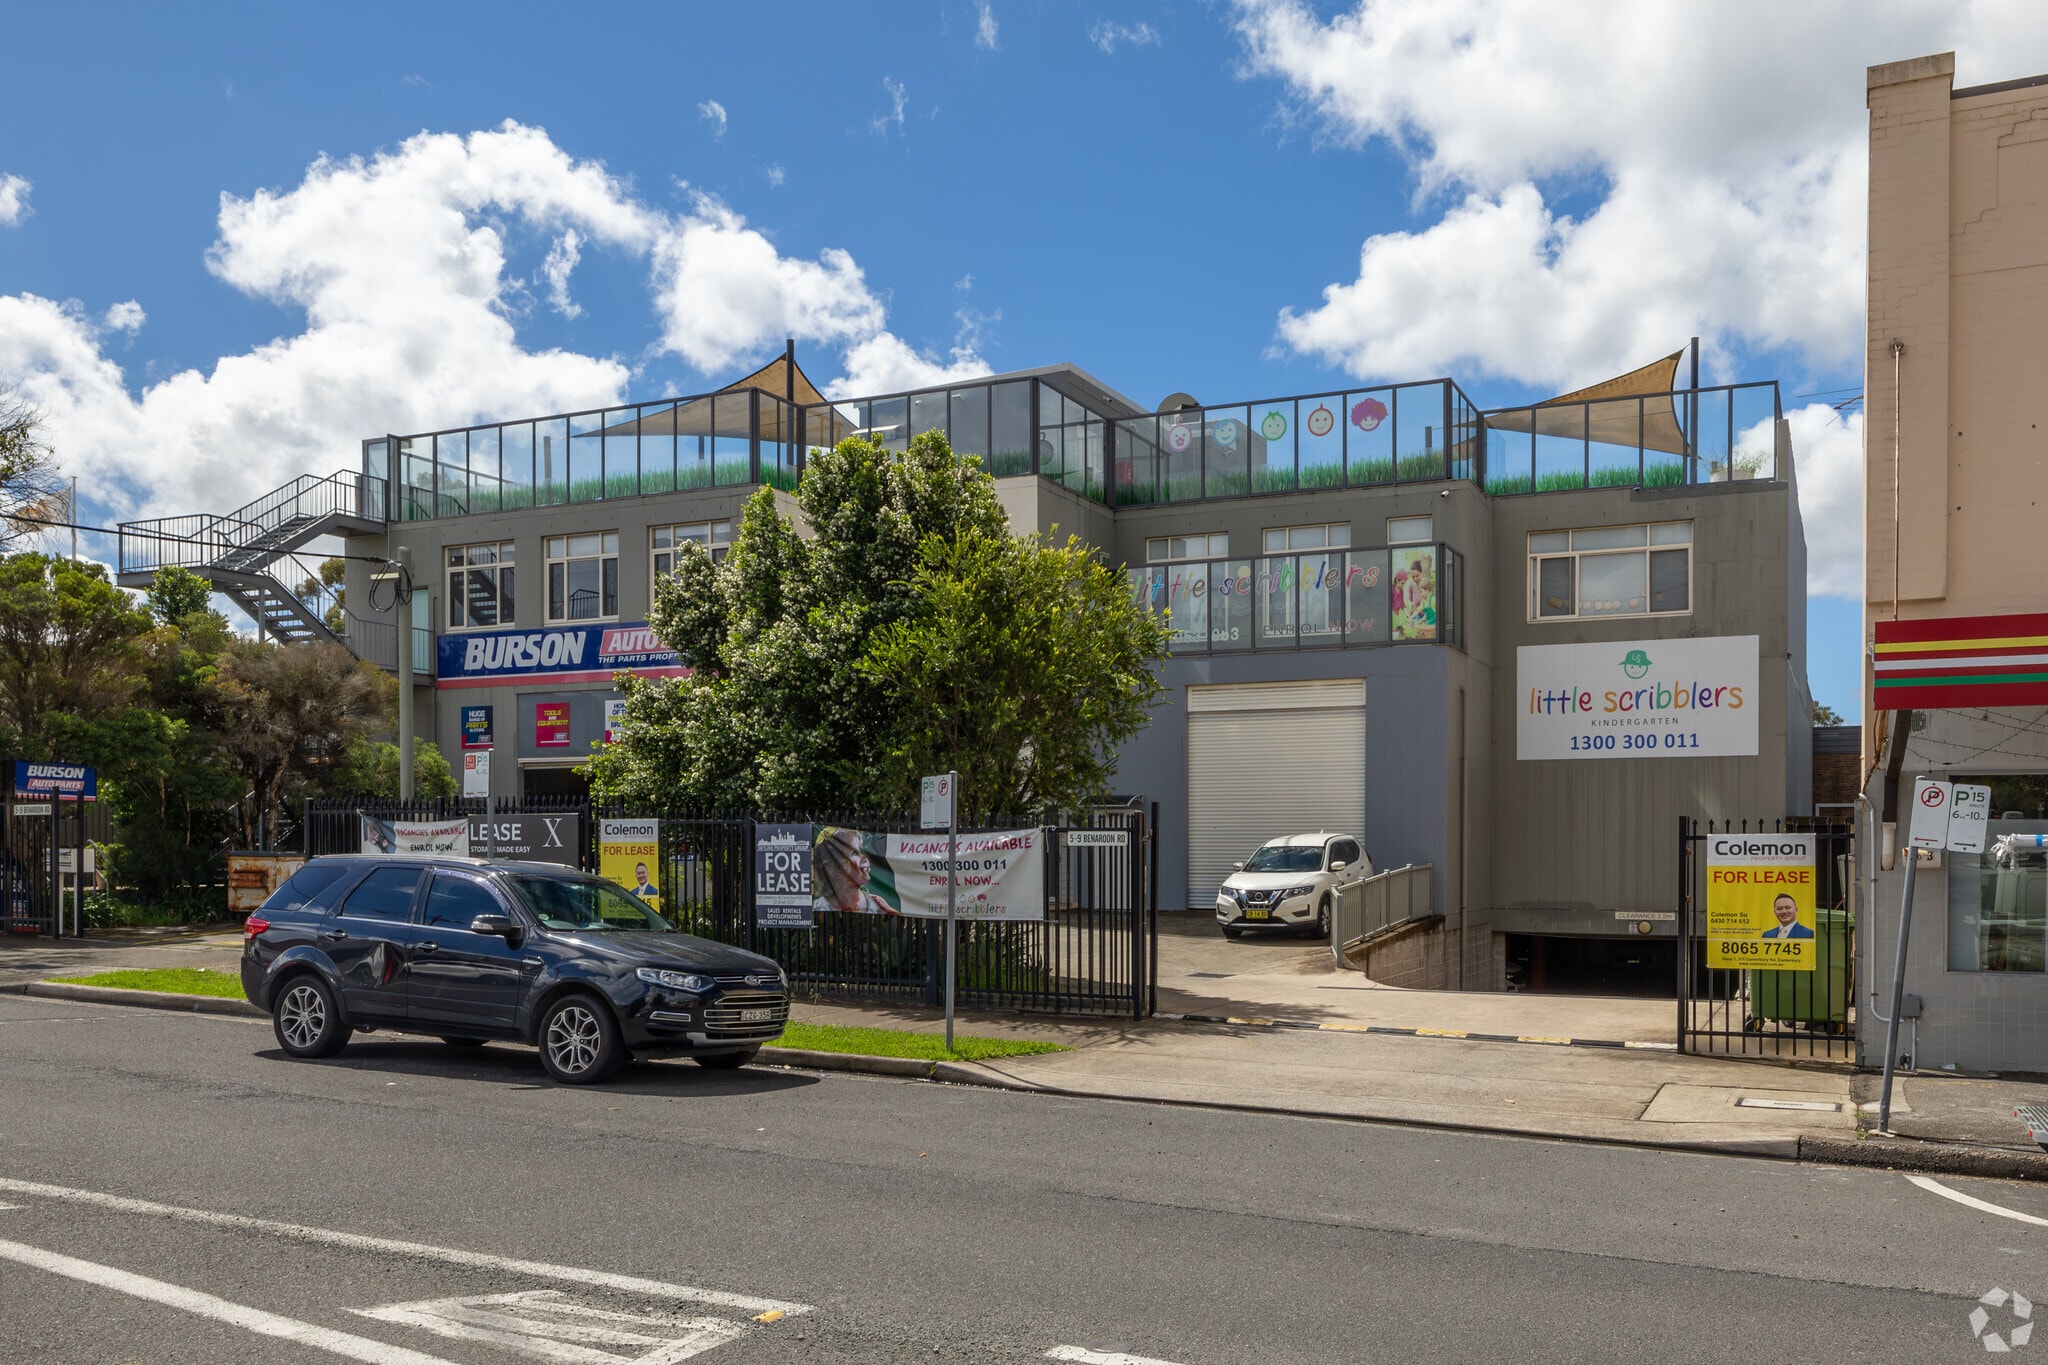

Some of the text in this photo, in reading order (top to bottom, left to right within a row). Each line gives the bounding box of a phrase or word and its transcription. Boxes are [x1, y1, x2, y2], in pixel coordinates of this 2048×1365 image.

[1263, 618, 1375, 636] ENROL NOW
[464, 631, 587, 671] BURSON
[598, 656, 615, 664] THE
[617, 654, 647, 663] PARTS
[1529, 682, 1744, 715] little scribblers
[465, 721, 488, 729] PARTS
[1590, 717, 1679, 727] KINDERGARTEN
[1570, 733, 1700, 750] 1300 300 011
[27, 764, 85, 779] BURSON
[1954, 790, 1985, 806] P 15
[396, 826, 466, 837] VACANCIES AVAILABLE
[470, 818, 564, 848] LEASE X
[604, 824, 654, 835] Colemon
[1069, 834, 1126, 843] 5-9 BENAROON RD
[410, 843, 433, 852] ENROL
[603, 846, 655, 856] FOR LEASE
[900, 837, 1032, 854] VACANCIS AVAILABLE
[1714, 840, 1807, 856] Colemon
[765, 852, 801, 872] FOR
[921, 859, 1007, 871] 1300 300 011
[757, 873, 810, 893] LEASE
[929, 875, 961, 886] ENRL
[1713, 871, 1810, 883] FOR LEASE
[955, 903, 1007, 914] scribblers
[1721, 942, 1802, 955] 8065 7745
